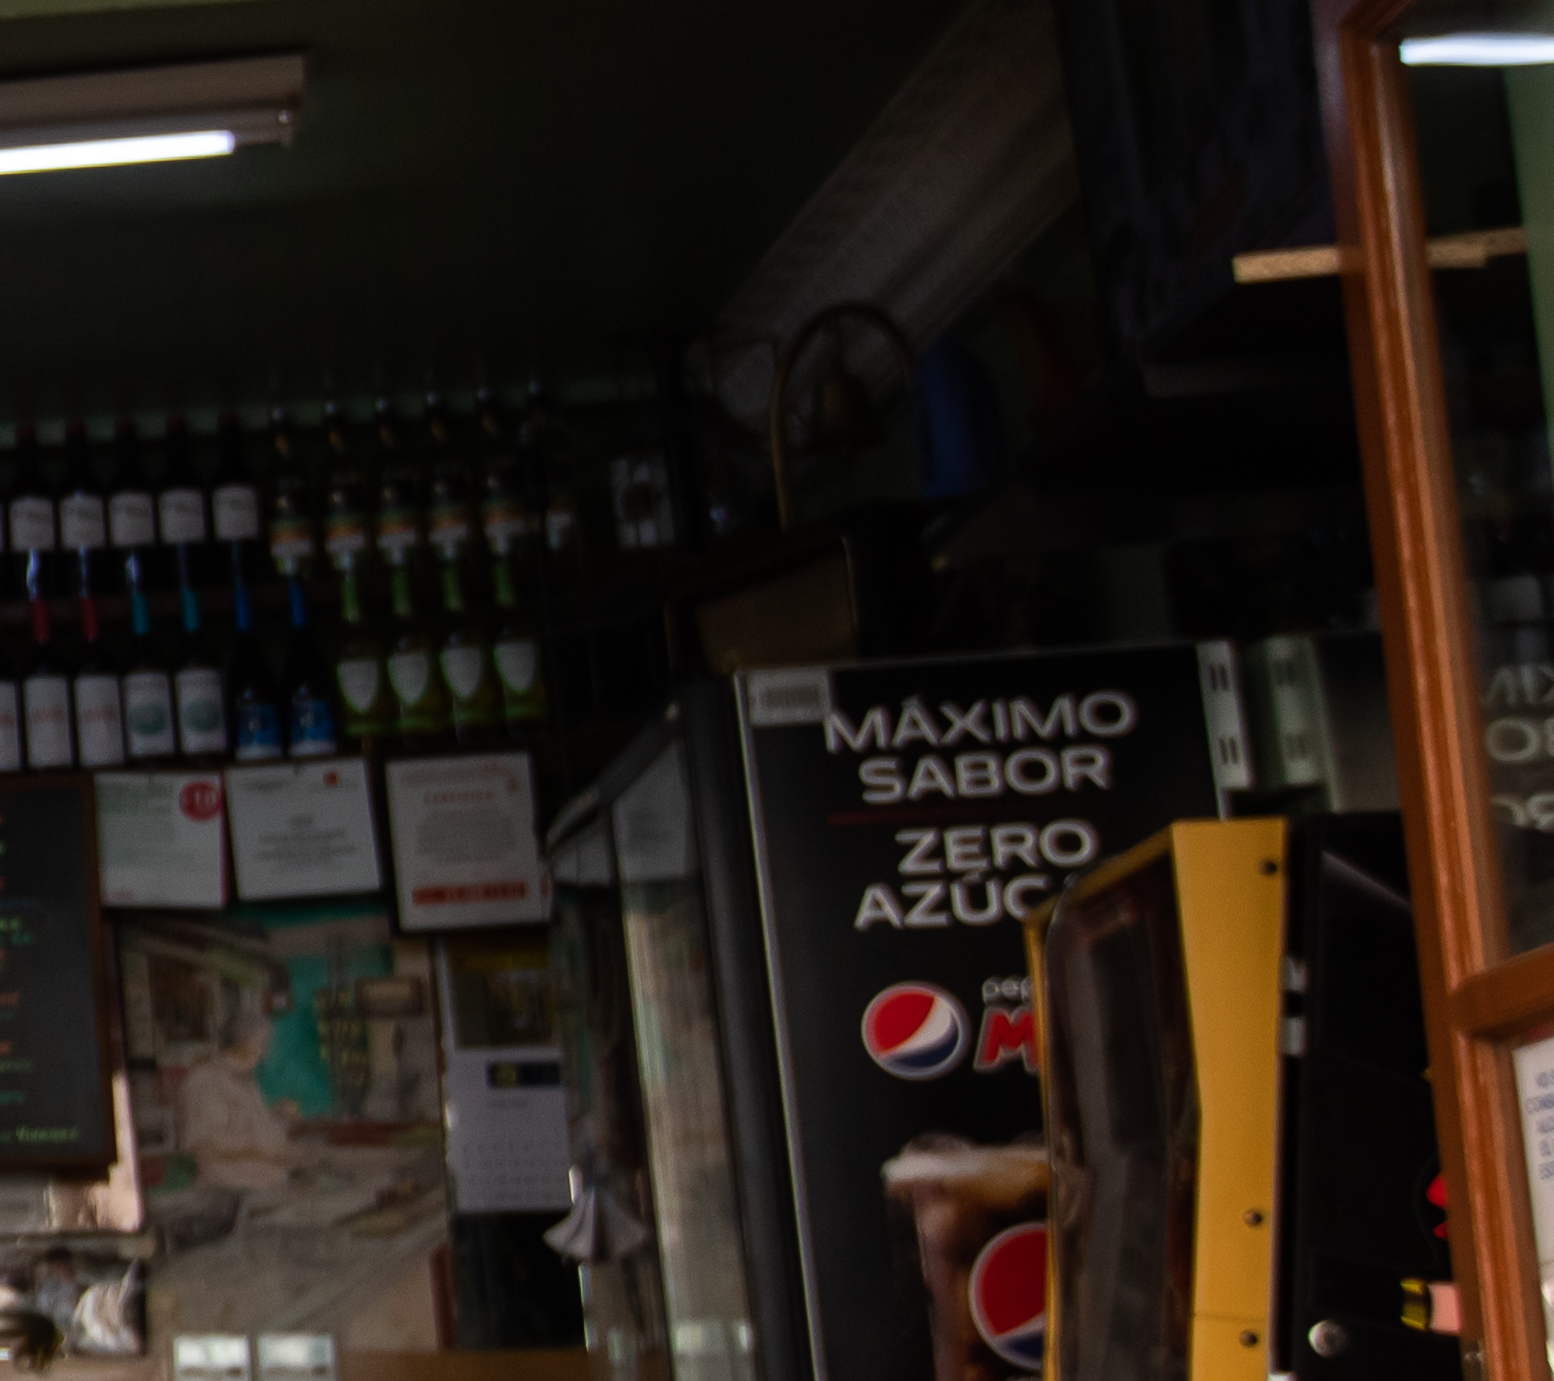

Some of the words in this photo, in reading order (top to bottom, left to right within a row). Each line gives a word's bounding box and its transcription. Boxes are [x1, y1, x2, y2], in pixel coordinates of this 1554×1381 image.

[823, 687, 1141, 755] MÁXIMO
[857, 744, 1117, 806] SABOR
[894, 817, 1102, 876] ZERO
[852, 872, 1052, 932] AZÚC
